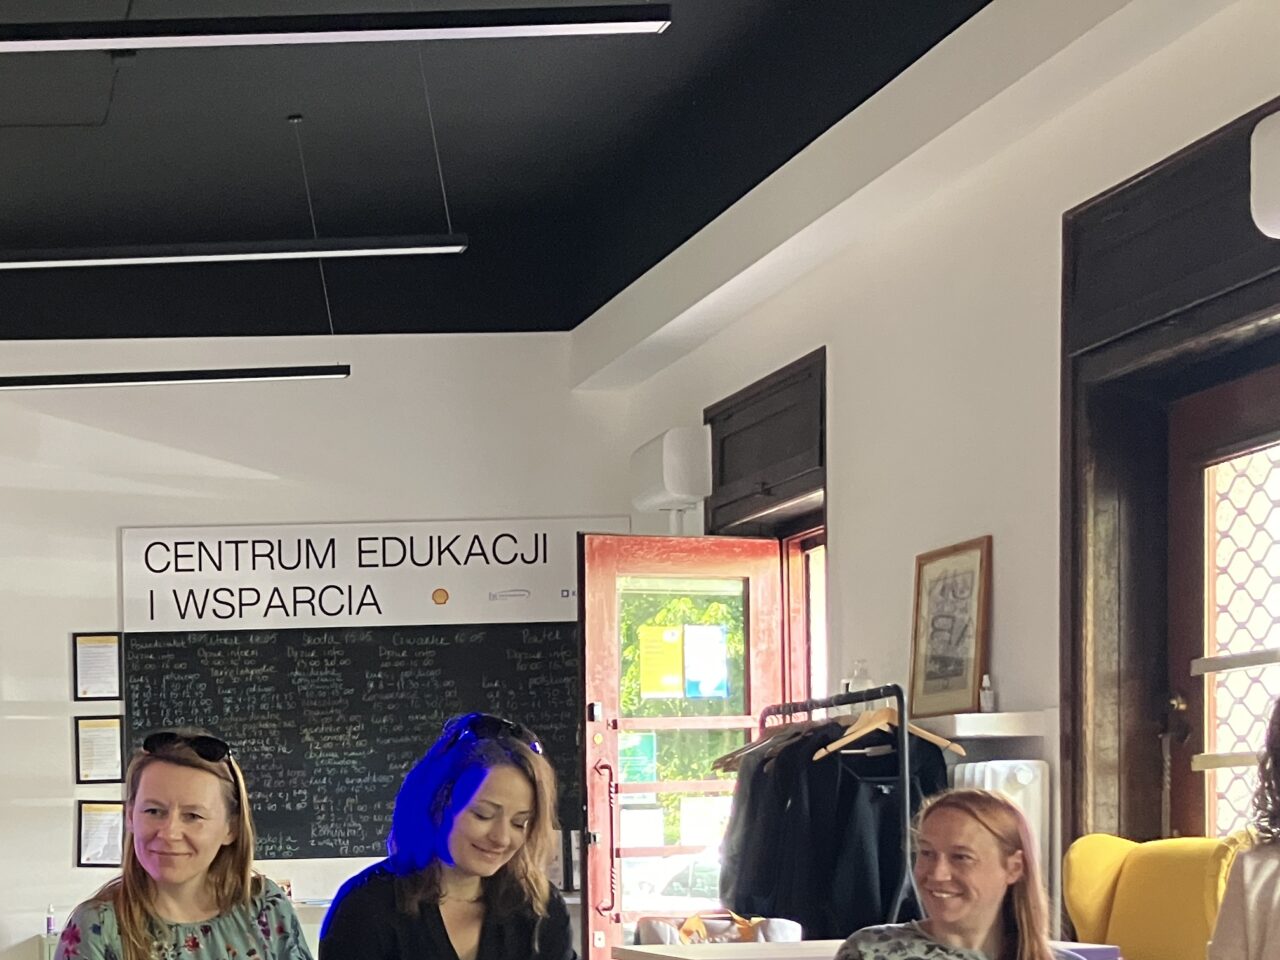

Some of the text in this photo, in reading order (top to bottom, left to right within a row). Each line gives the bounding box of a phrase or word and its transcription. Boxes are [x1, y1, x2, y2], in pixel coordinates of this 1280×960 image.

[144, 532, 548, 574] CENTRUM EDUKACJI
[150, 584, 383, 621] I WSPARCIA
